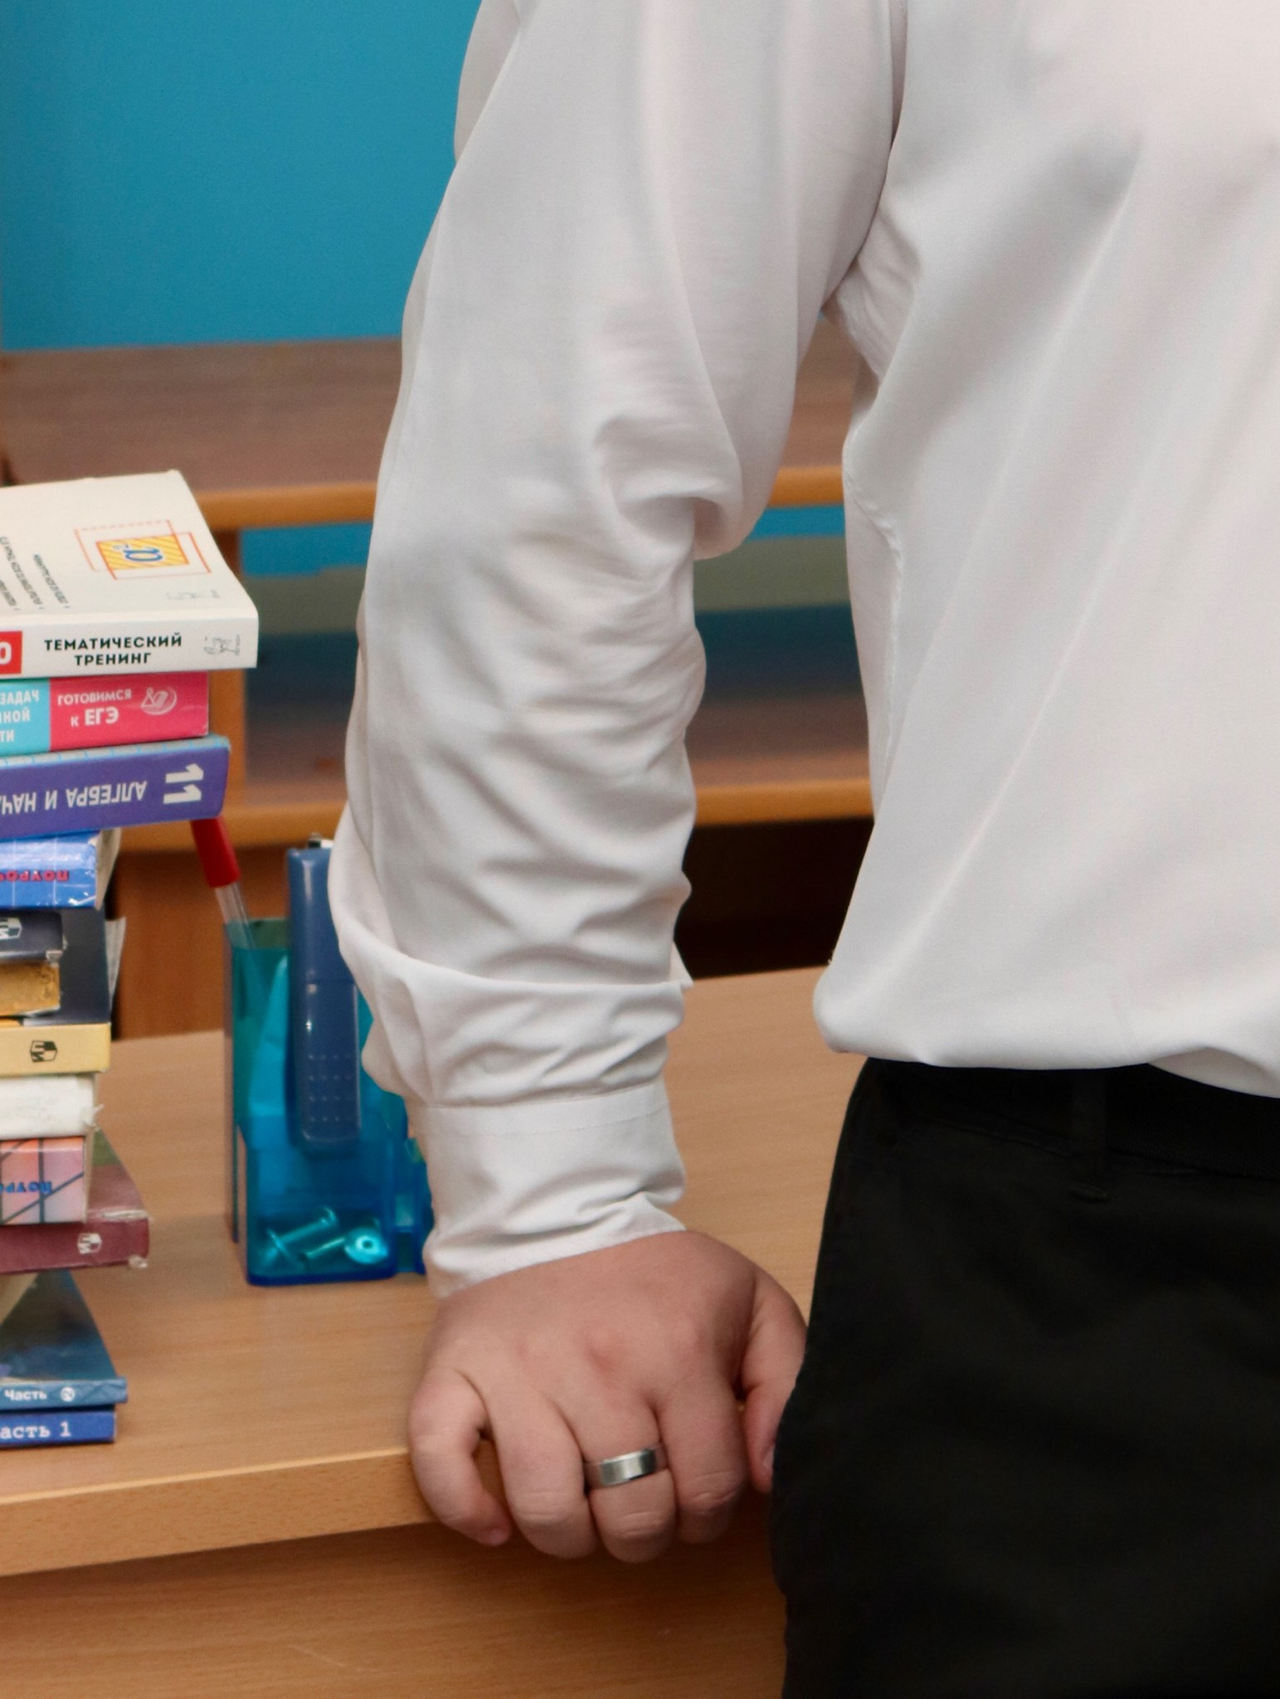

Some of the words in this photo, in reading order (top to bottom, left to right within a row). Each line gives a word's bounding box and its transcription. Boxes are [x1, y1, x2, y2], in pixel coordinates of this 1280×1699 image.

[44, 633, 182, 651] ТЕМАТИЧЕСКИЙ
[75, 653, 151, 666] ТРЕНИНГ
[57, 689, 132, 705] ГОТОВИМСЯ
[85, 706, 119, 725] ЕГЭ
[163, 763, 204, 804] 11
[45, 790, 57, 810] И
[66, 781, 147, 808] АЛГЕБРА
[5, 1389, 47, 1400] Часть
[60, 1421, 71, 1437] 1
